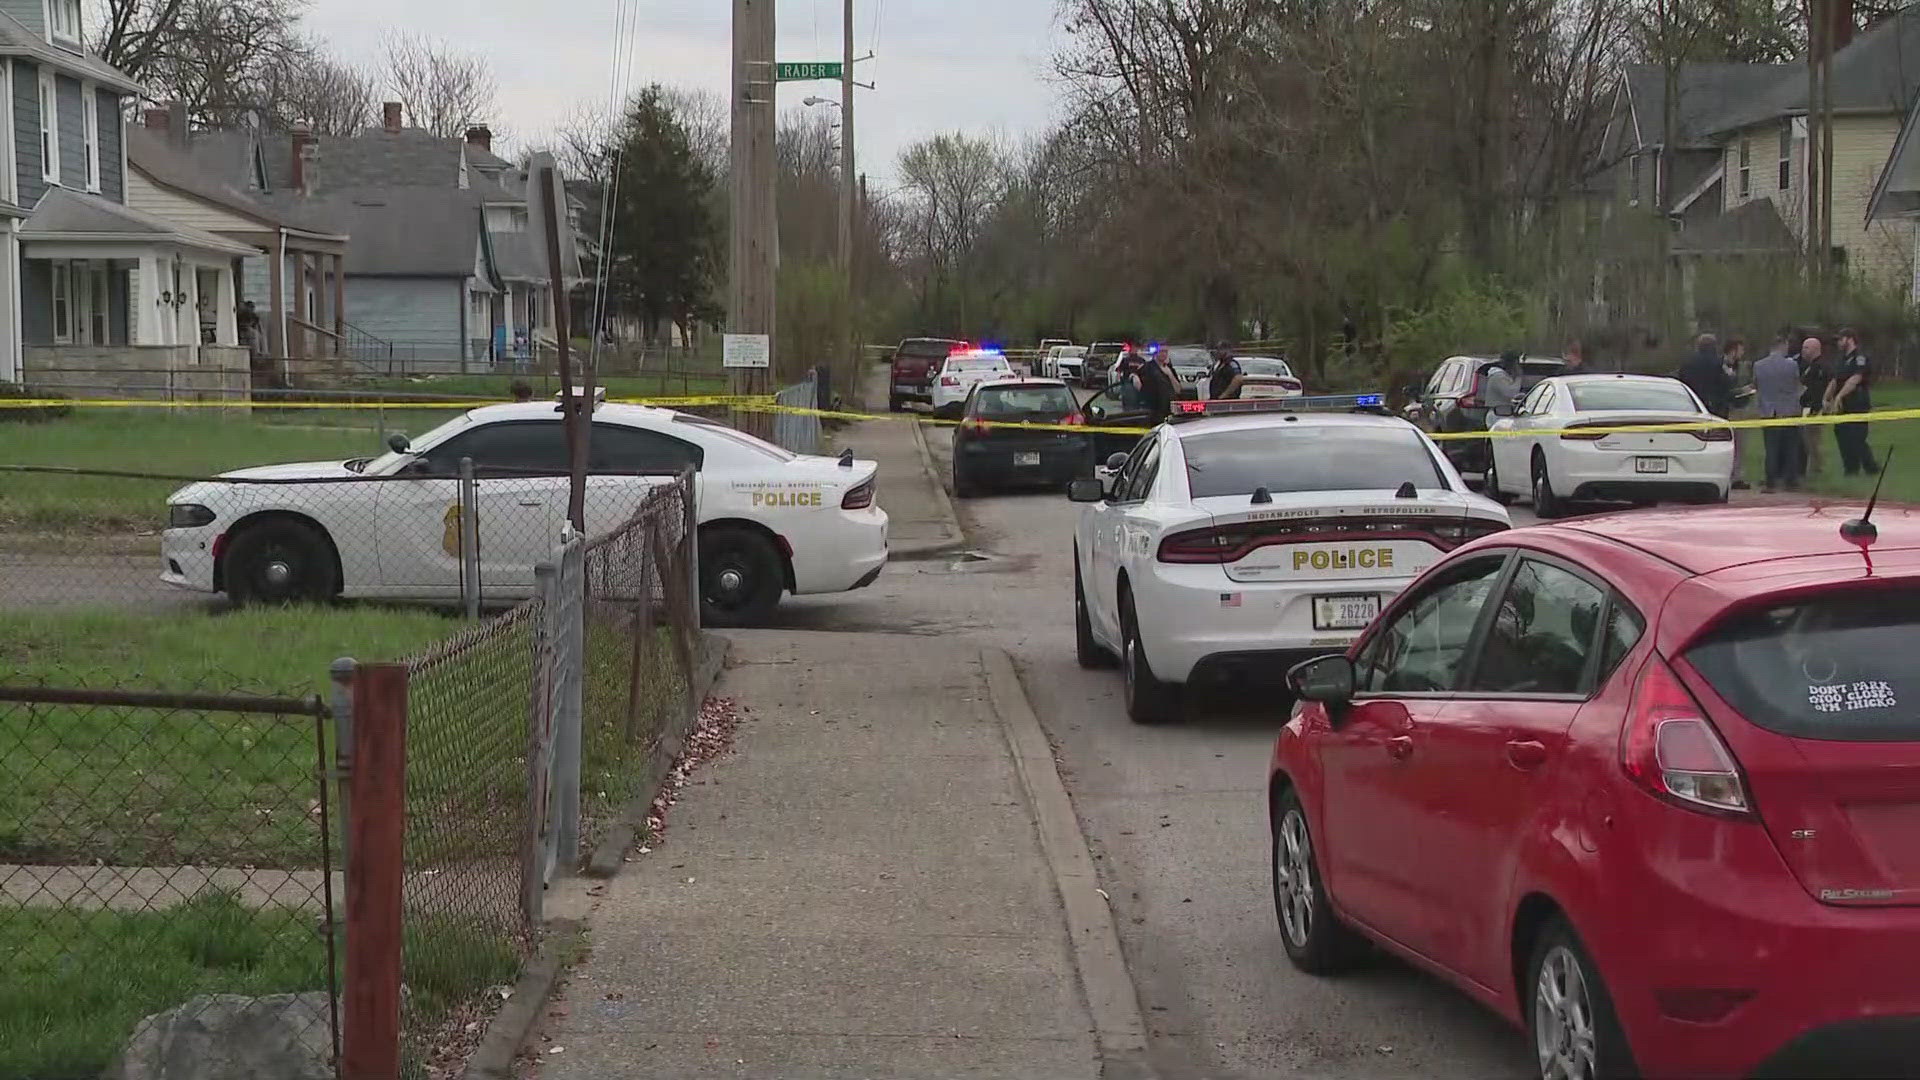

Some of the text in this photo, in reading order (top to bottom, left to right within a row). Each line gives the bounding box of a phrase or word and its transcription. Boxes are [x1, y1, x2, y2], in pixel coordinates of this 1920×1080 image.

[784, 64, 826, 77] RADER
[752, 492, 822, 506] POLICE
[1247, 506, 1437, 521] INDIANAPOLIS METROPOLITAN
[1293, 548, 1393, 570] POLICE
[1340, 603, 1374, 619] 26228
[1808, 681, 1891, 695] DON'T PARK
[1817, 689, 1886, 704] TOO CLOSE
[1821, 698, 1888, 712] I'M THICK
[1791, 829, 1816, 839] SE
